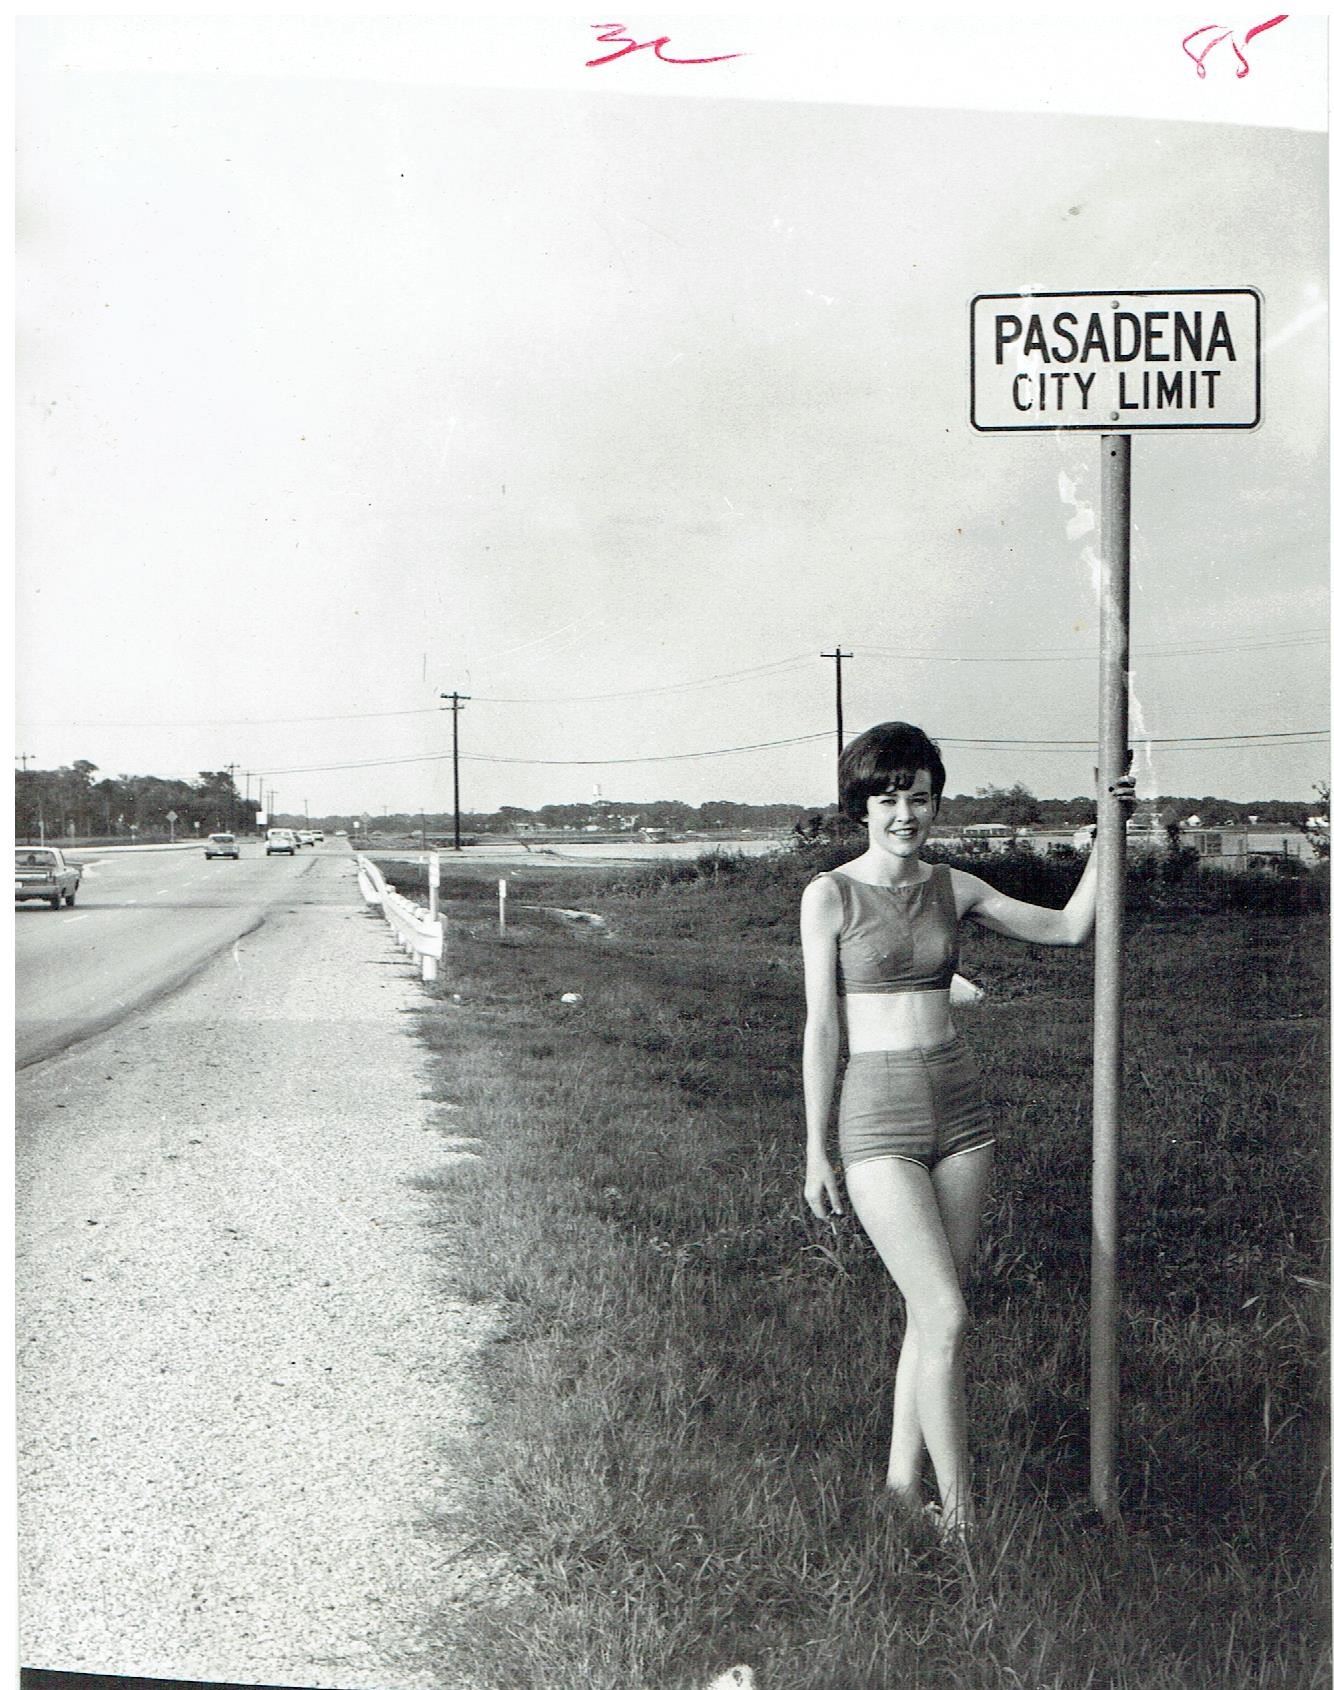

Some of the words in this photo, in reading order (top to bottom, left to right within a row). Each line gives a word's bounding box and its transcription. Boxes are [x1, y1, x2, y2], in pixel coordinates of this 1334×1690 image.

[995, 310, 1237, 365] PASADENA
[1012, 372, 1096, 411] CITY
[1119, 370, 1221, 410] LIMIT
